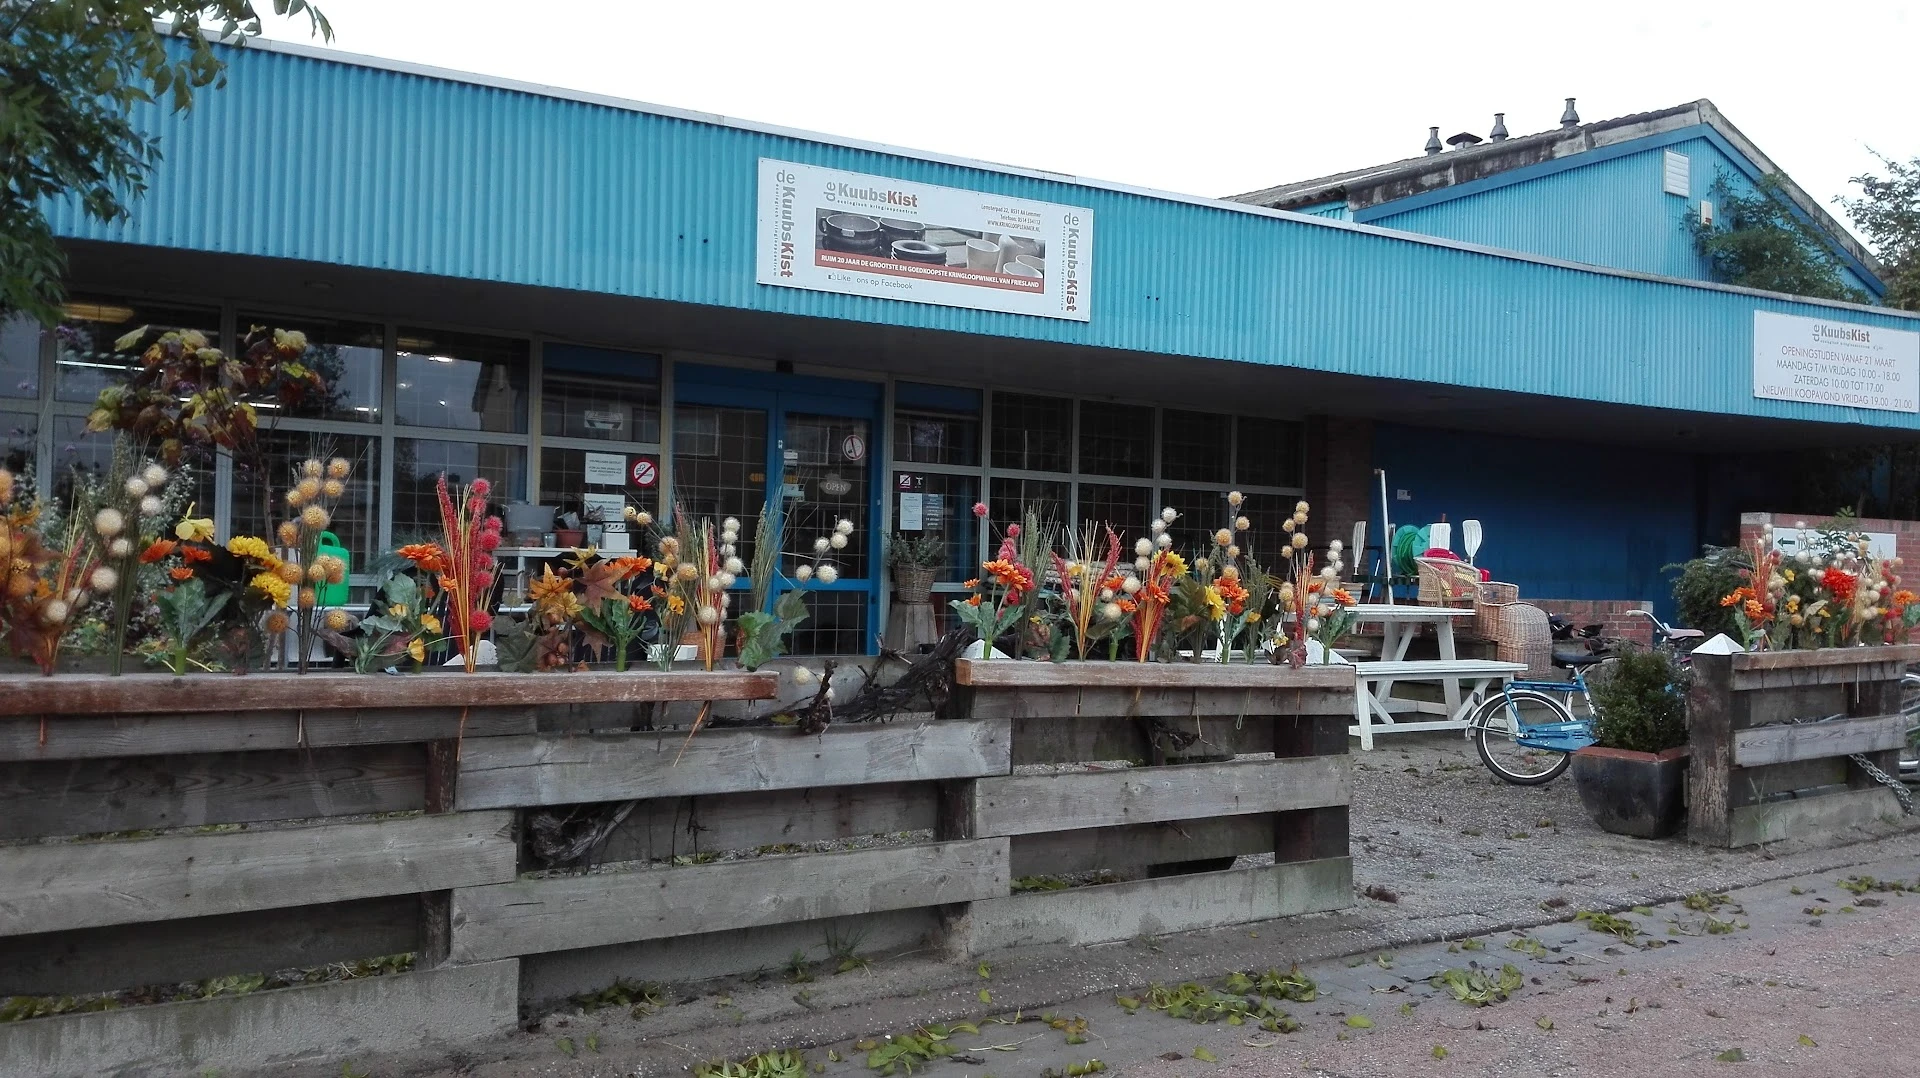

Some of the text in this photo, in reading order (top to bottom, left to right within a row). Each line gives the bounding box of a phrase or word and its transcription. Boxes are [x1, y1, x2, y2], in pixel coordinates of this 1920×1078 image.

[776, 169, 796, 185] de
[823, 181, 918, 208] de KuubsKist
[1063, 212, 1080, 226] de
[780, 185, 796, 278] KuubsKist
[820, 254, 837, 263] RUIM
[845, 257, 860, 266] JAAR
[869, 260, 899, 271] GROOTSTE
[899, 264, 908, 272] EN
[907, 264, 948, 277] GOEDKOOPSTE
[948, 270, 999, 284] KRINGLOOPWINKEL
[999, 277, 1011, 285] VAN
[1011, 278, 1040, 288] FRIESLAND
[1066, 227, 1080, 312] KuubsKist
[836, 273, 913, 290] Like ons op Facebook
[1812, 324, 1871, 343] de KuubsKist
[1840, 353, 1863, 364] VANAF
[1864, 355, 1872, 365] 21
[1874, 357, 1896, 368] MAART
[1776, 359, 1813, 372] MAANDAG
[1814, 363, 1828, 374] T/M
[1828, 364, 1856, 377] VRIJDAG
[1858, 368, 1877, 379] 10.00
[1883, 370, 1901, 382] 18.00
[1793, 374, 1884, 393] ZATERDAG 10.00 TOT 17.00
[1762, 385, 1793, 397] NIEUW!!!
[1794, 388, 1840, 402] KOOPAVOND
[1841, 393, 1869, 405] VRIJDAG
[1870, 396, 1889, 407] 19.00
[1894, 398, 1913, 409] 21.00
[825, 482, 847, 492] OPEN
